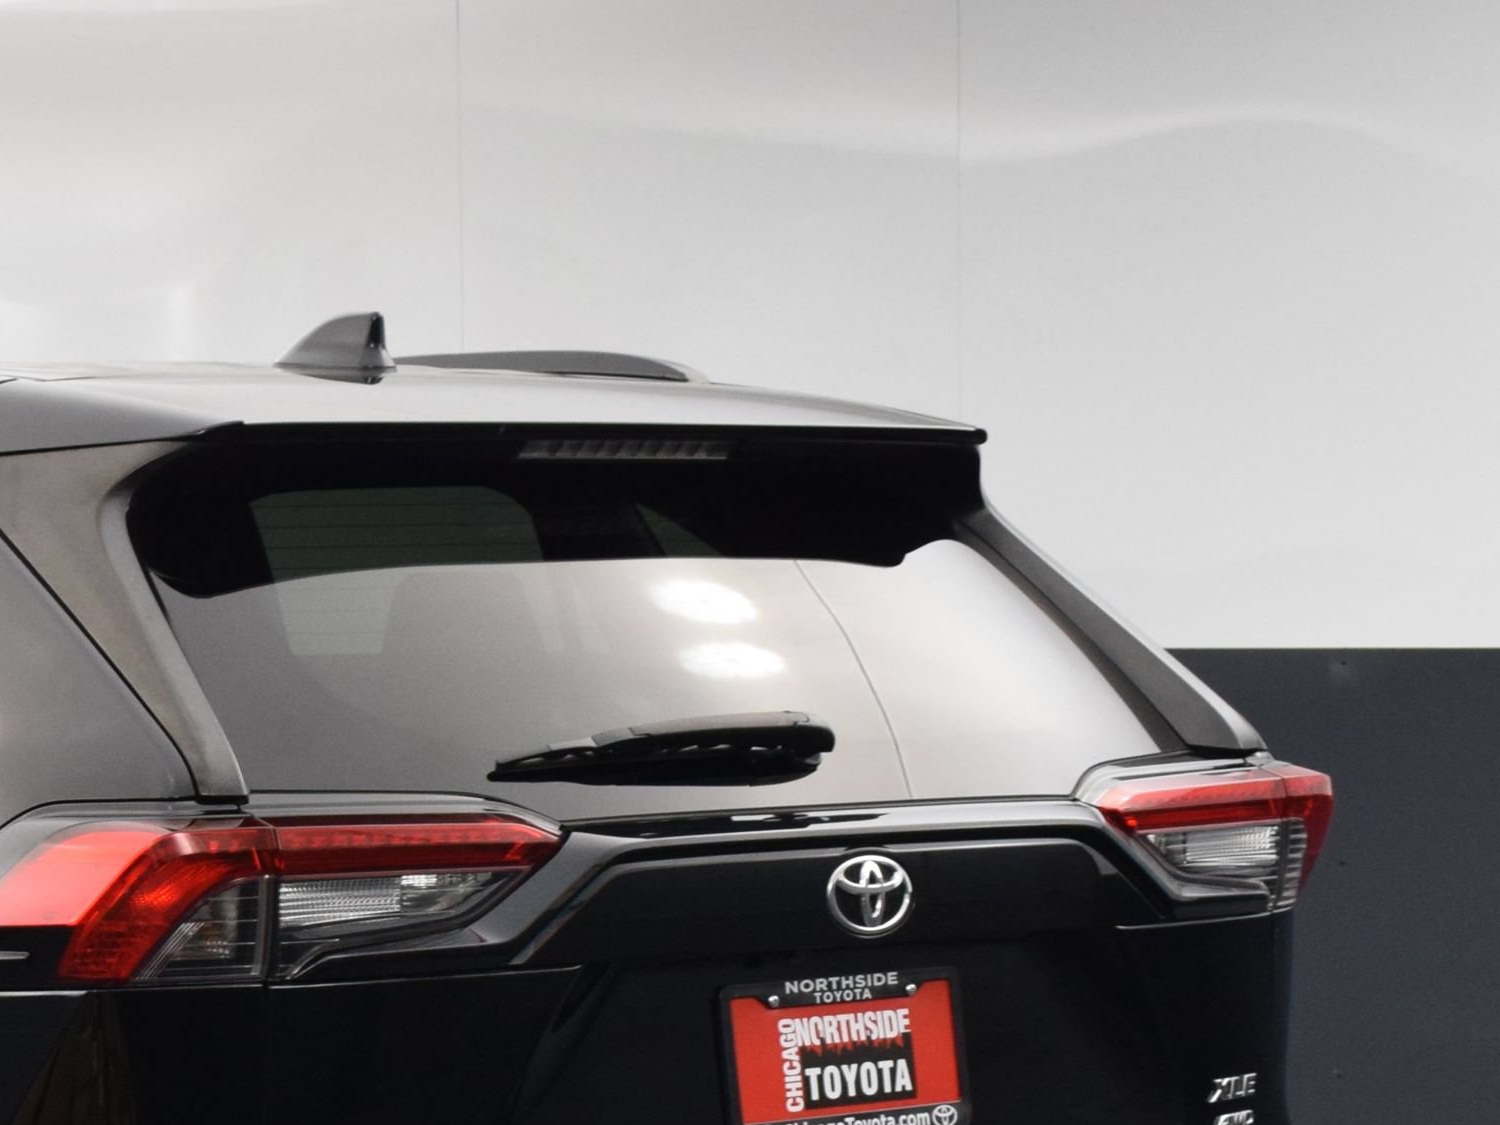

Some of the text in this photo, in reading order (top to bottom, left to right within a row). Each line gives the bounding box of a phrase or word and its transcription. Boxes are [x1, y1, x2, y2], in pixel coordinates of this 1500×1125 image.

[784, 972, 899, 994] NORTHSIDE
[814, 988, 873, 1004] TOYOTA
[793, 1008, 912, 1047] NORTHSIDE
[777, 1018, 805, 1113] CHICAGO
[805, 1059, 913, 1101] TOYOTA
